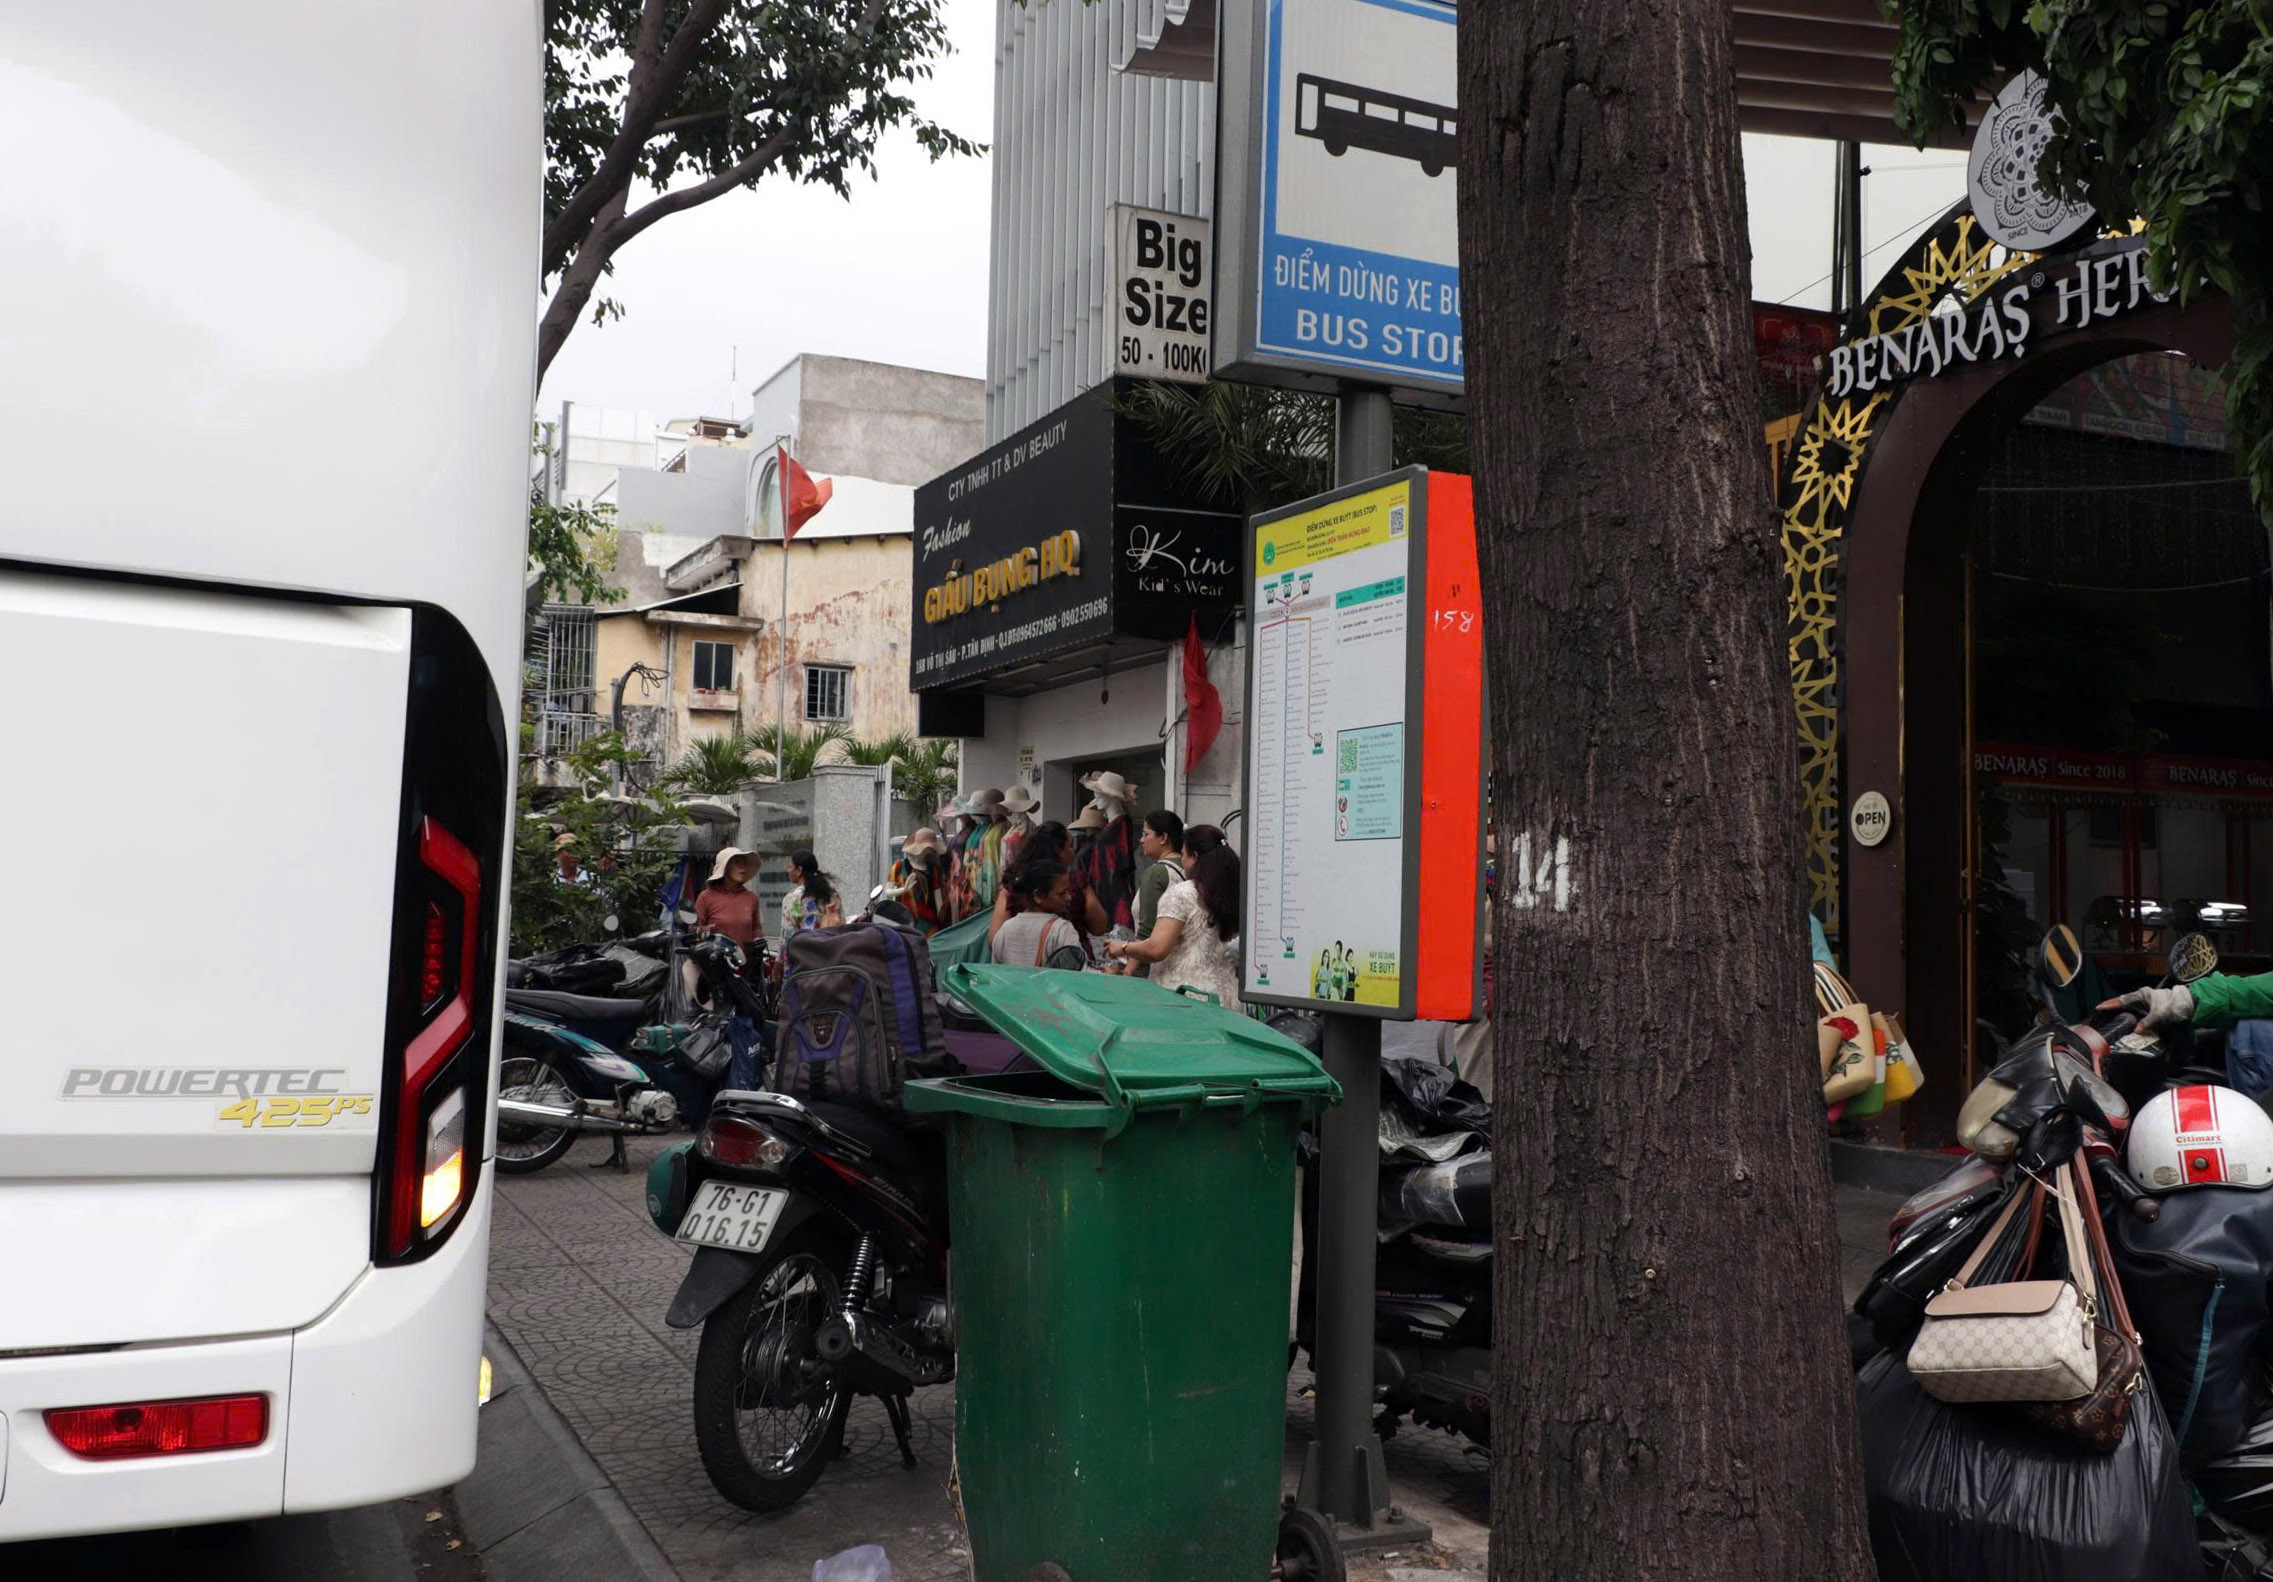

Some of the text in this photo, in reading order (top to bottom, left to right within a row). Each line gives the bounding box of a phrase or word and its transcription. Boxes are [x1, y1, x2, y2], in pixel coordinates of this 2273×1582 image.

[1136, 217, 1203, 289] Big
[1275, 247, 1330, 294] ĐIỂM
[1338, 260, 1399, 306] DỪNG
[1405, 278, 1433, 312] XE
[1125, 276, 1208, 336] Size
[1296, 308, 1369, 350] BUS
[1121, 335, 1141, 365] 50
[949, 481, 965, 501] CTY
[968, 466, 989, 492] TNHH
[1004, 452, 1011, 473] &
[1014, 445, 1027, 468] DV
[1030, 420, 1067, 459] BEAUTY
[923, 515, 971, 562] Fashion
[1041, 530, 1081, 580] HQ
[1434, 609, 1474, 633] 158
[1855, 811, 1886, 825] OPEN
[61, 1069, 345, 1099] POWERTEC
[2176, 1135, 2221, 1143] Citimart
[706, 1186, 771, 1216] 76-G1
[684, 1213, 766, 1248] 016.15
